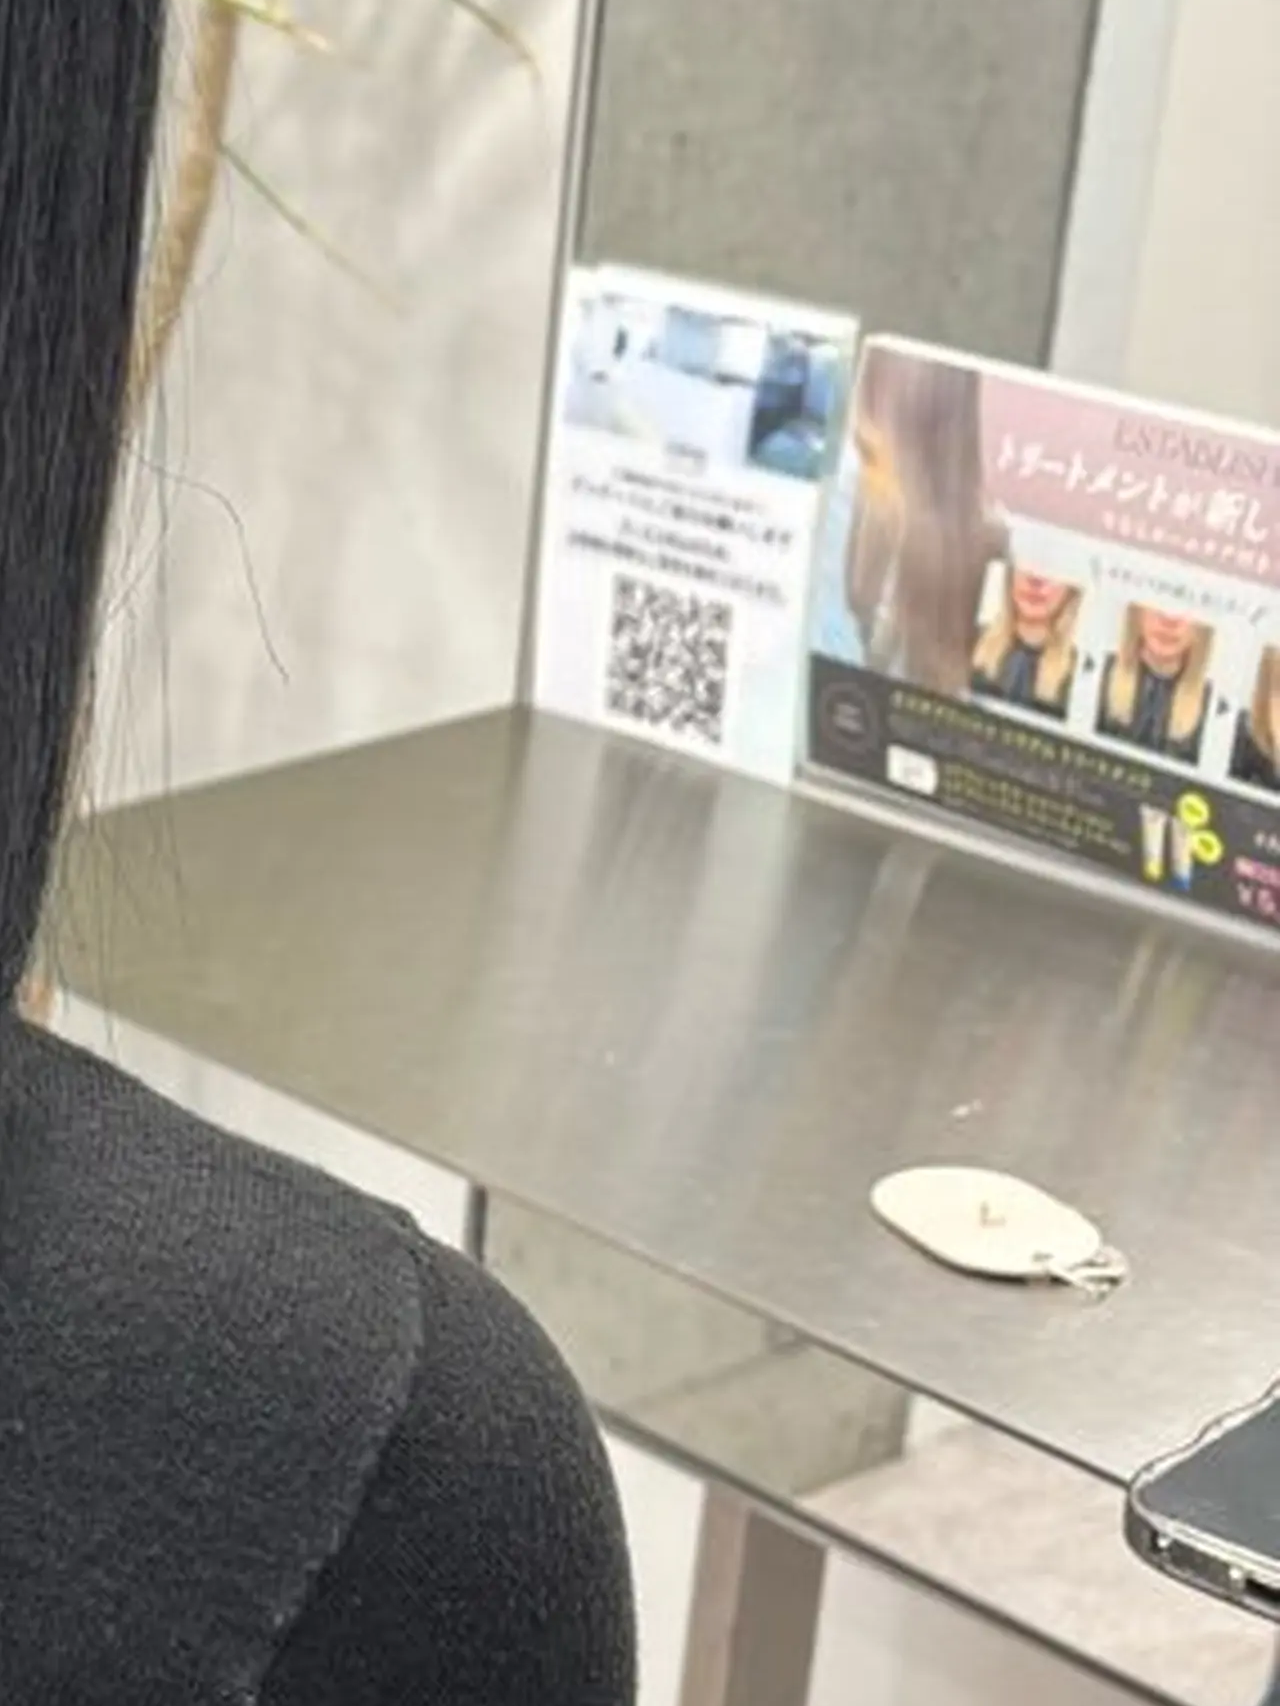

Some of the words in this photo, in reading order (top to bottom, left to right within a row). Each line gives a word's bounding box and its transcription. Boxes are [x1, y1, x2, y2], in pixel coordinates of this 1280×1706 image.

[997, 432, 1280, 543] トリートメントが新し
